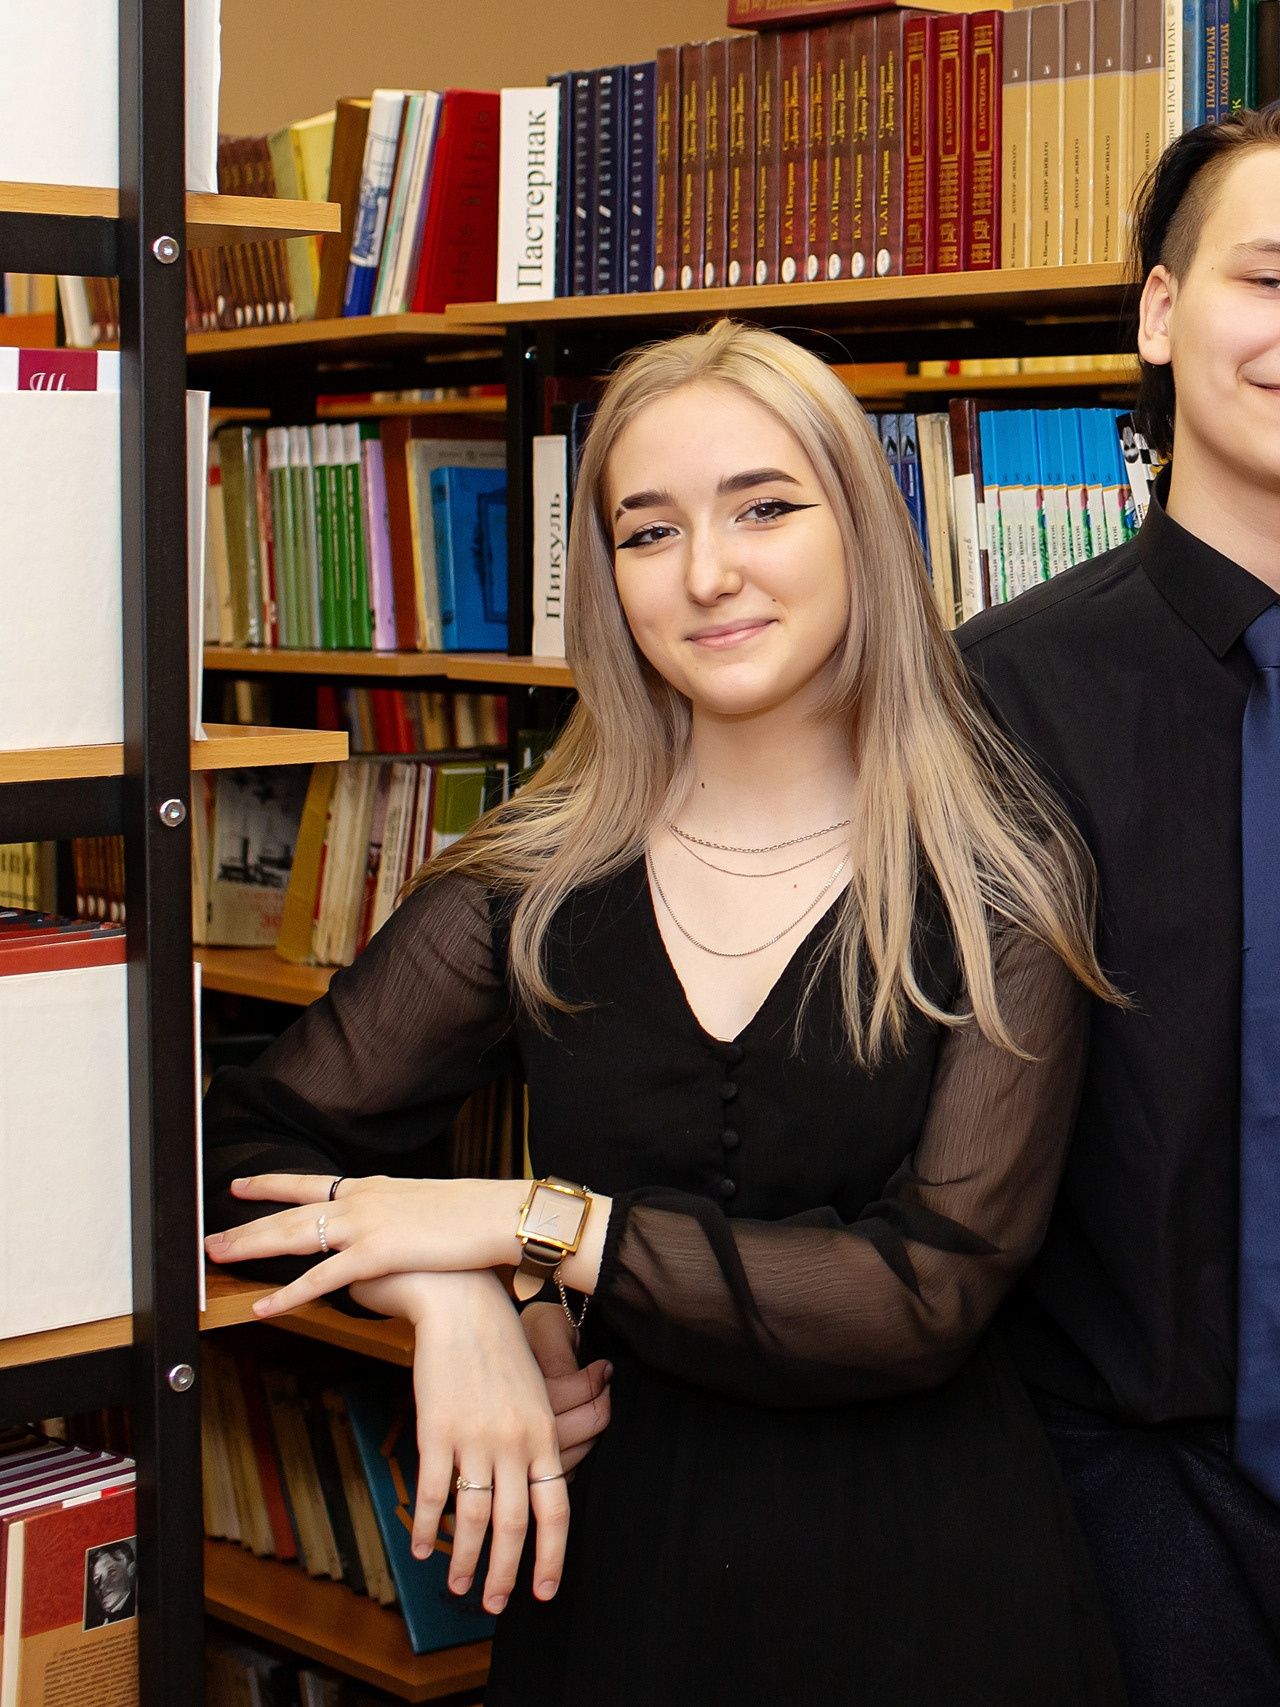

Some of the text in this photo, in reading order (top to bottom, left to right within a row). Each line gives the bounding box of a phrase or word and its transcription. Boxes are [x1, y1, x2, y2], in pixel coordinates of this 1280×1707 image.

[945, 72, 953, 133] ПАСТЕРНАК
[1167, 22, 1176, 114] ПАСТЕРНАК
[1206, 26, 1216, 108] ПАСТЕРНАК
[1220, 23, 1230, 105] ПАСТЕРНАК
[517, 110, 552, 288] Пастернак
[545, 493, 565, 619] Пикуль
